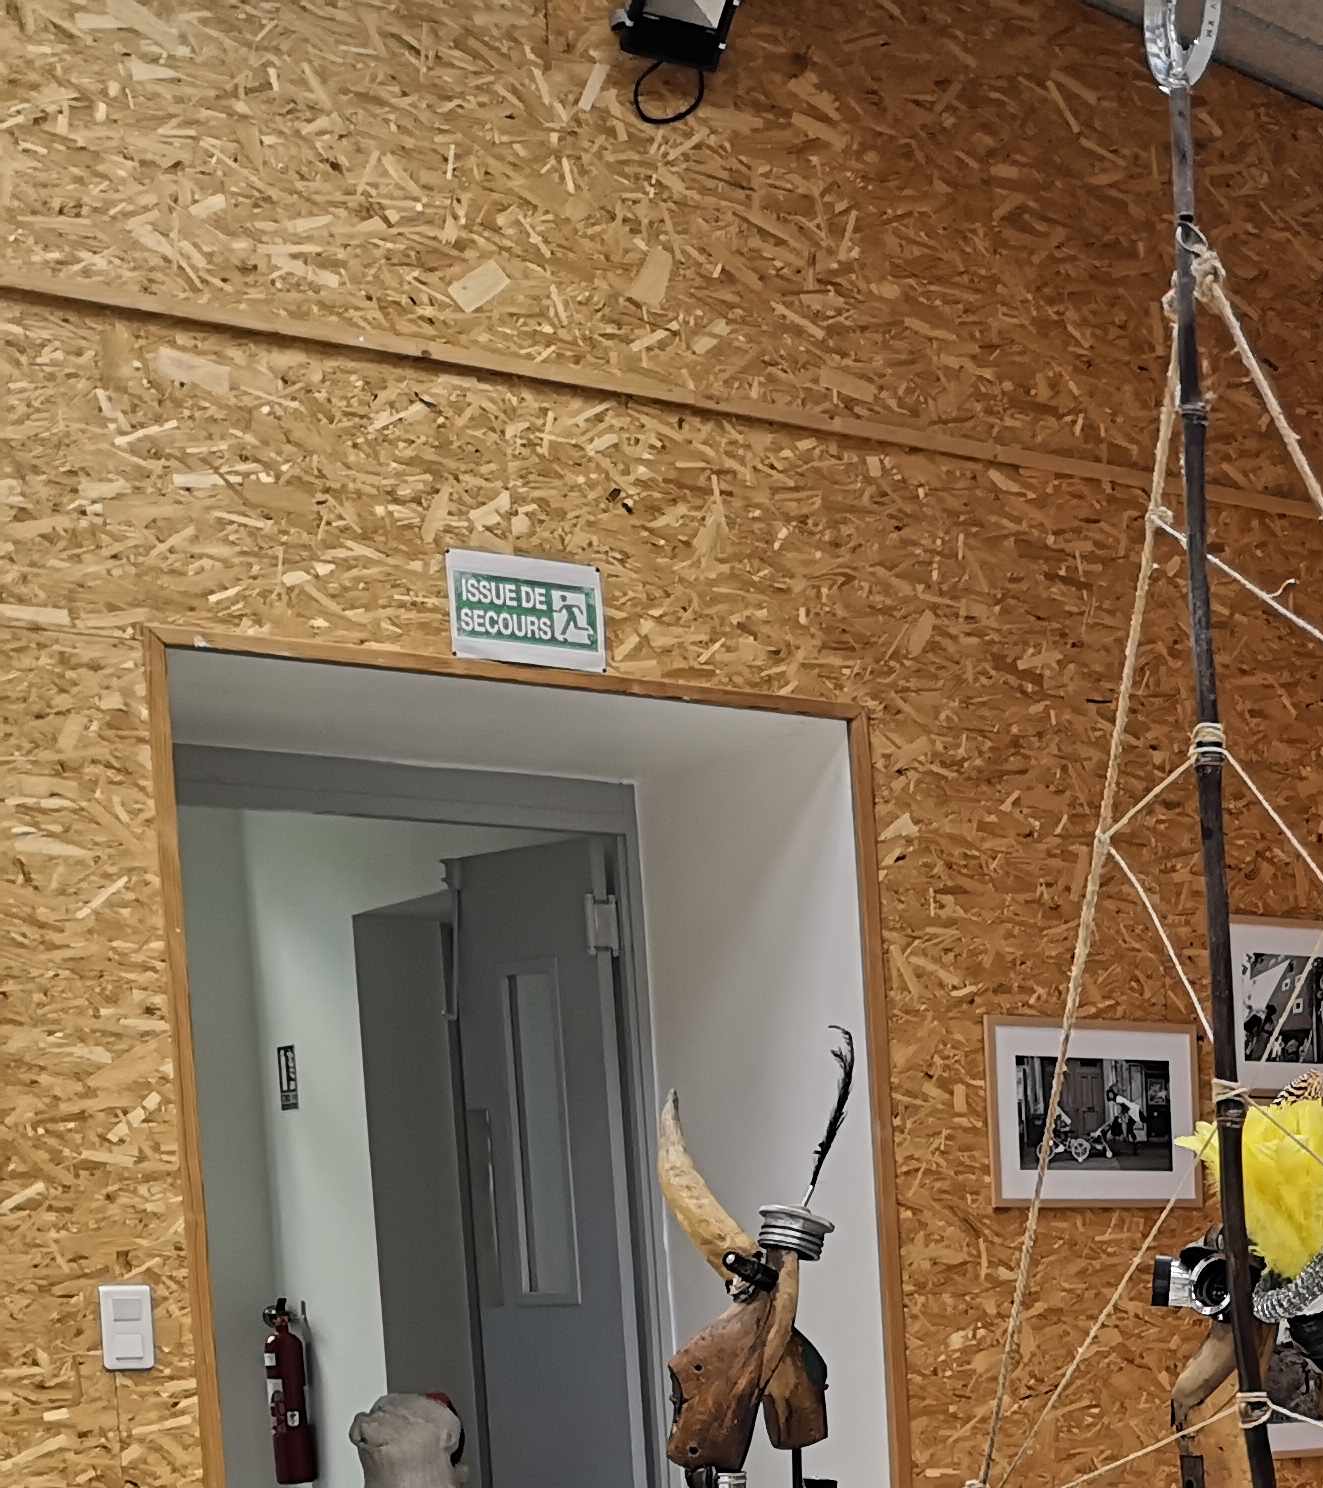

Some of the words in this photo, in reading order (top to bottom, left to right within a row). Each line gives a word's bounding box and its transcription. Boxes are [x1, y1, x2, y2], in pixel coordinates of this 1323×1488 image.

[461, 578, 517, 607] ISSUE
[521, 585, 548, 610] DE
[460, 608, 552, 640] SECOURS
